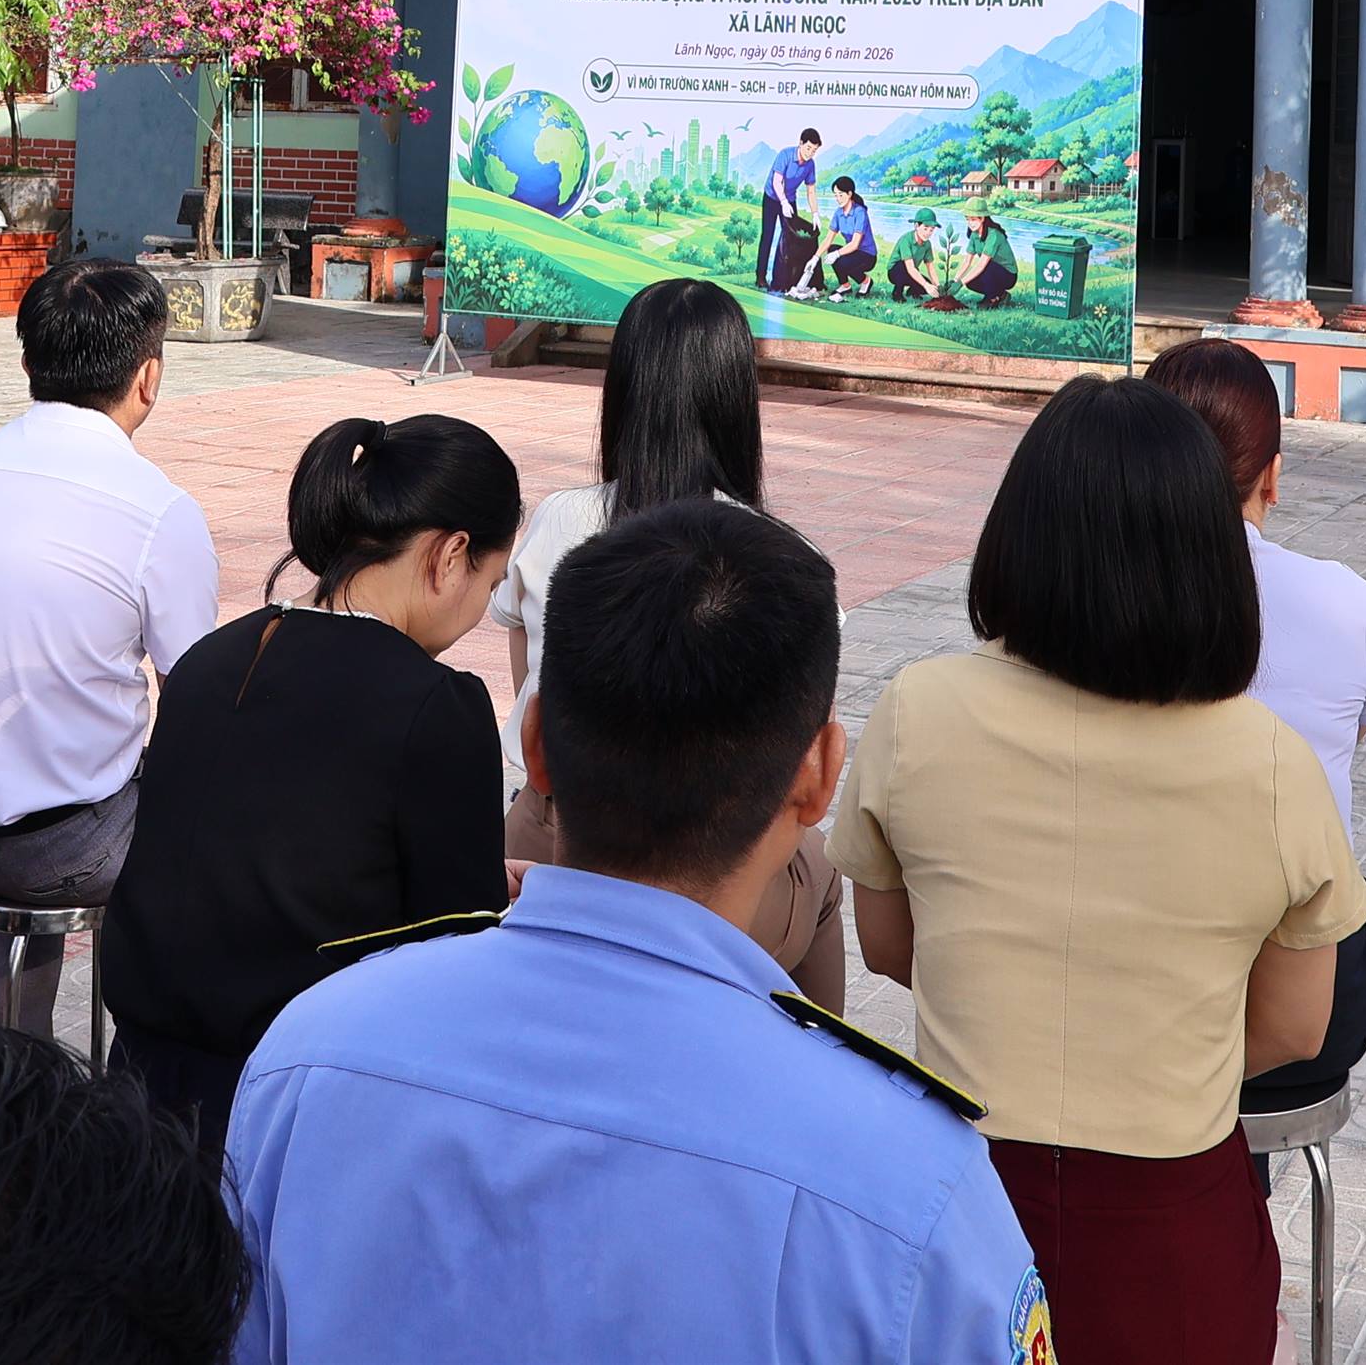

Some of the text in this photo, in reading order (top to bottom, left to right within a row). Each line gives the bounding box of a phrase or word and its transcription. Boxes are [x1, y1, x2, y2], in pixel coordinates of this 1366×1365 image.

[728, 11, 846, 38] XÃ LÃNH NGỌC
[674, 43, 894, 62] Lãnh Ngọc, ngày 05 tháng 6 năm 2026
[627, 74, 636, 89] VÌ
[639, 75, 657, 90] MÔI
[660, 75, 700, 91] TRƯỜNG
[702, 79, 729, 92] XANH
[740, 80, 766, 95] SẠCH
[777, 82, 800, 96] ĐẸP,
[804, 80, 824, 95] HÃY
[827, 80, 856, 96] HÀNH
[858, 81, 888, 99] ĐỘNG
[890, 84, 917, 98] NGAY
[920, 83, 944, 98] HÔM
[946, 86, 971, 99] NAY!
